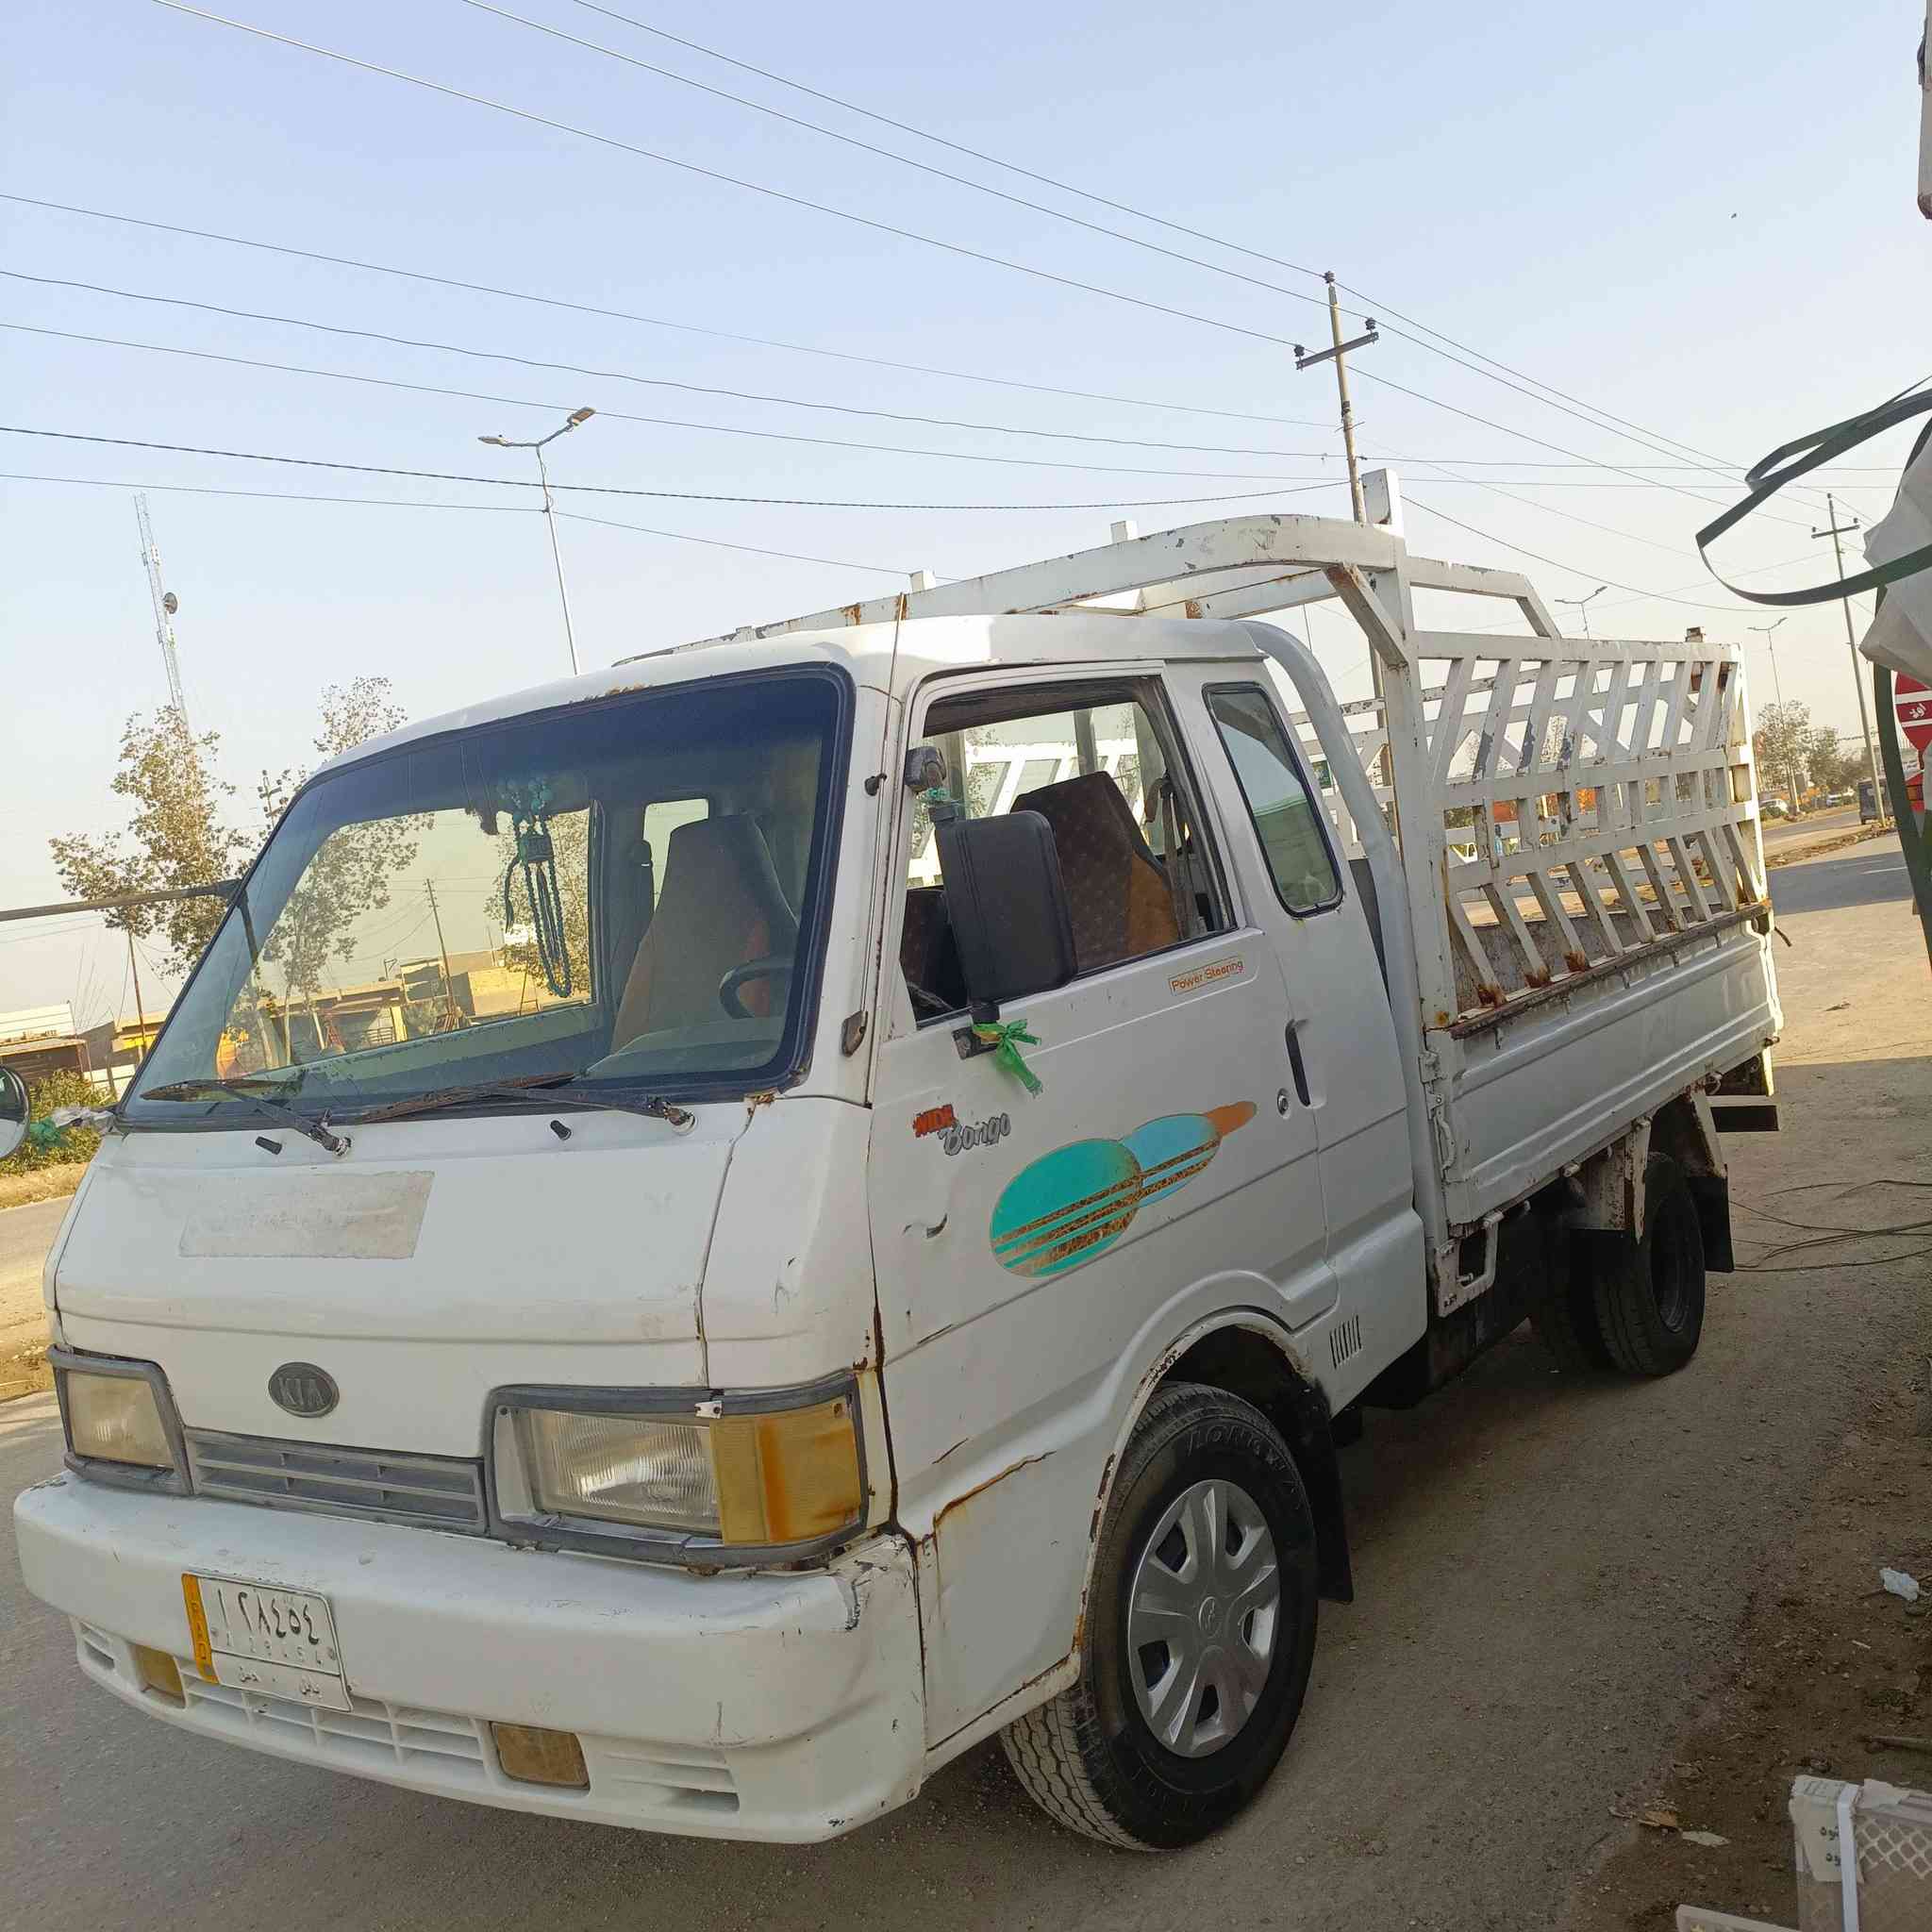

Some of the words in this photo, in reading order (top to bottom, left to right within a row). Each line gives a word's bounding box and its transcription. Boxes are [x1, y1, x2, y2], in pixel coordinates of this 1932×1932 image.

[1171, 974, 1203, 993] Power
[1205, 960, 1244, 979] Steering
[937, 1112, 1012, 1157] Bongo
[276, 1376, 326, 1406] KIA
